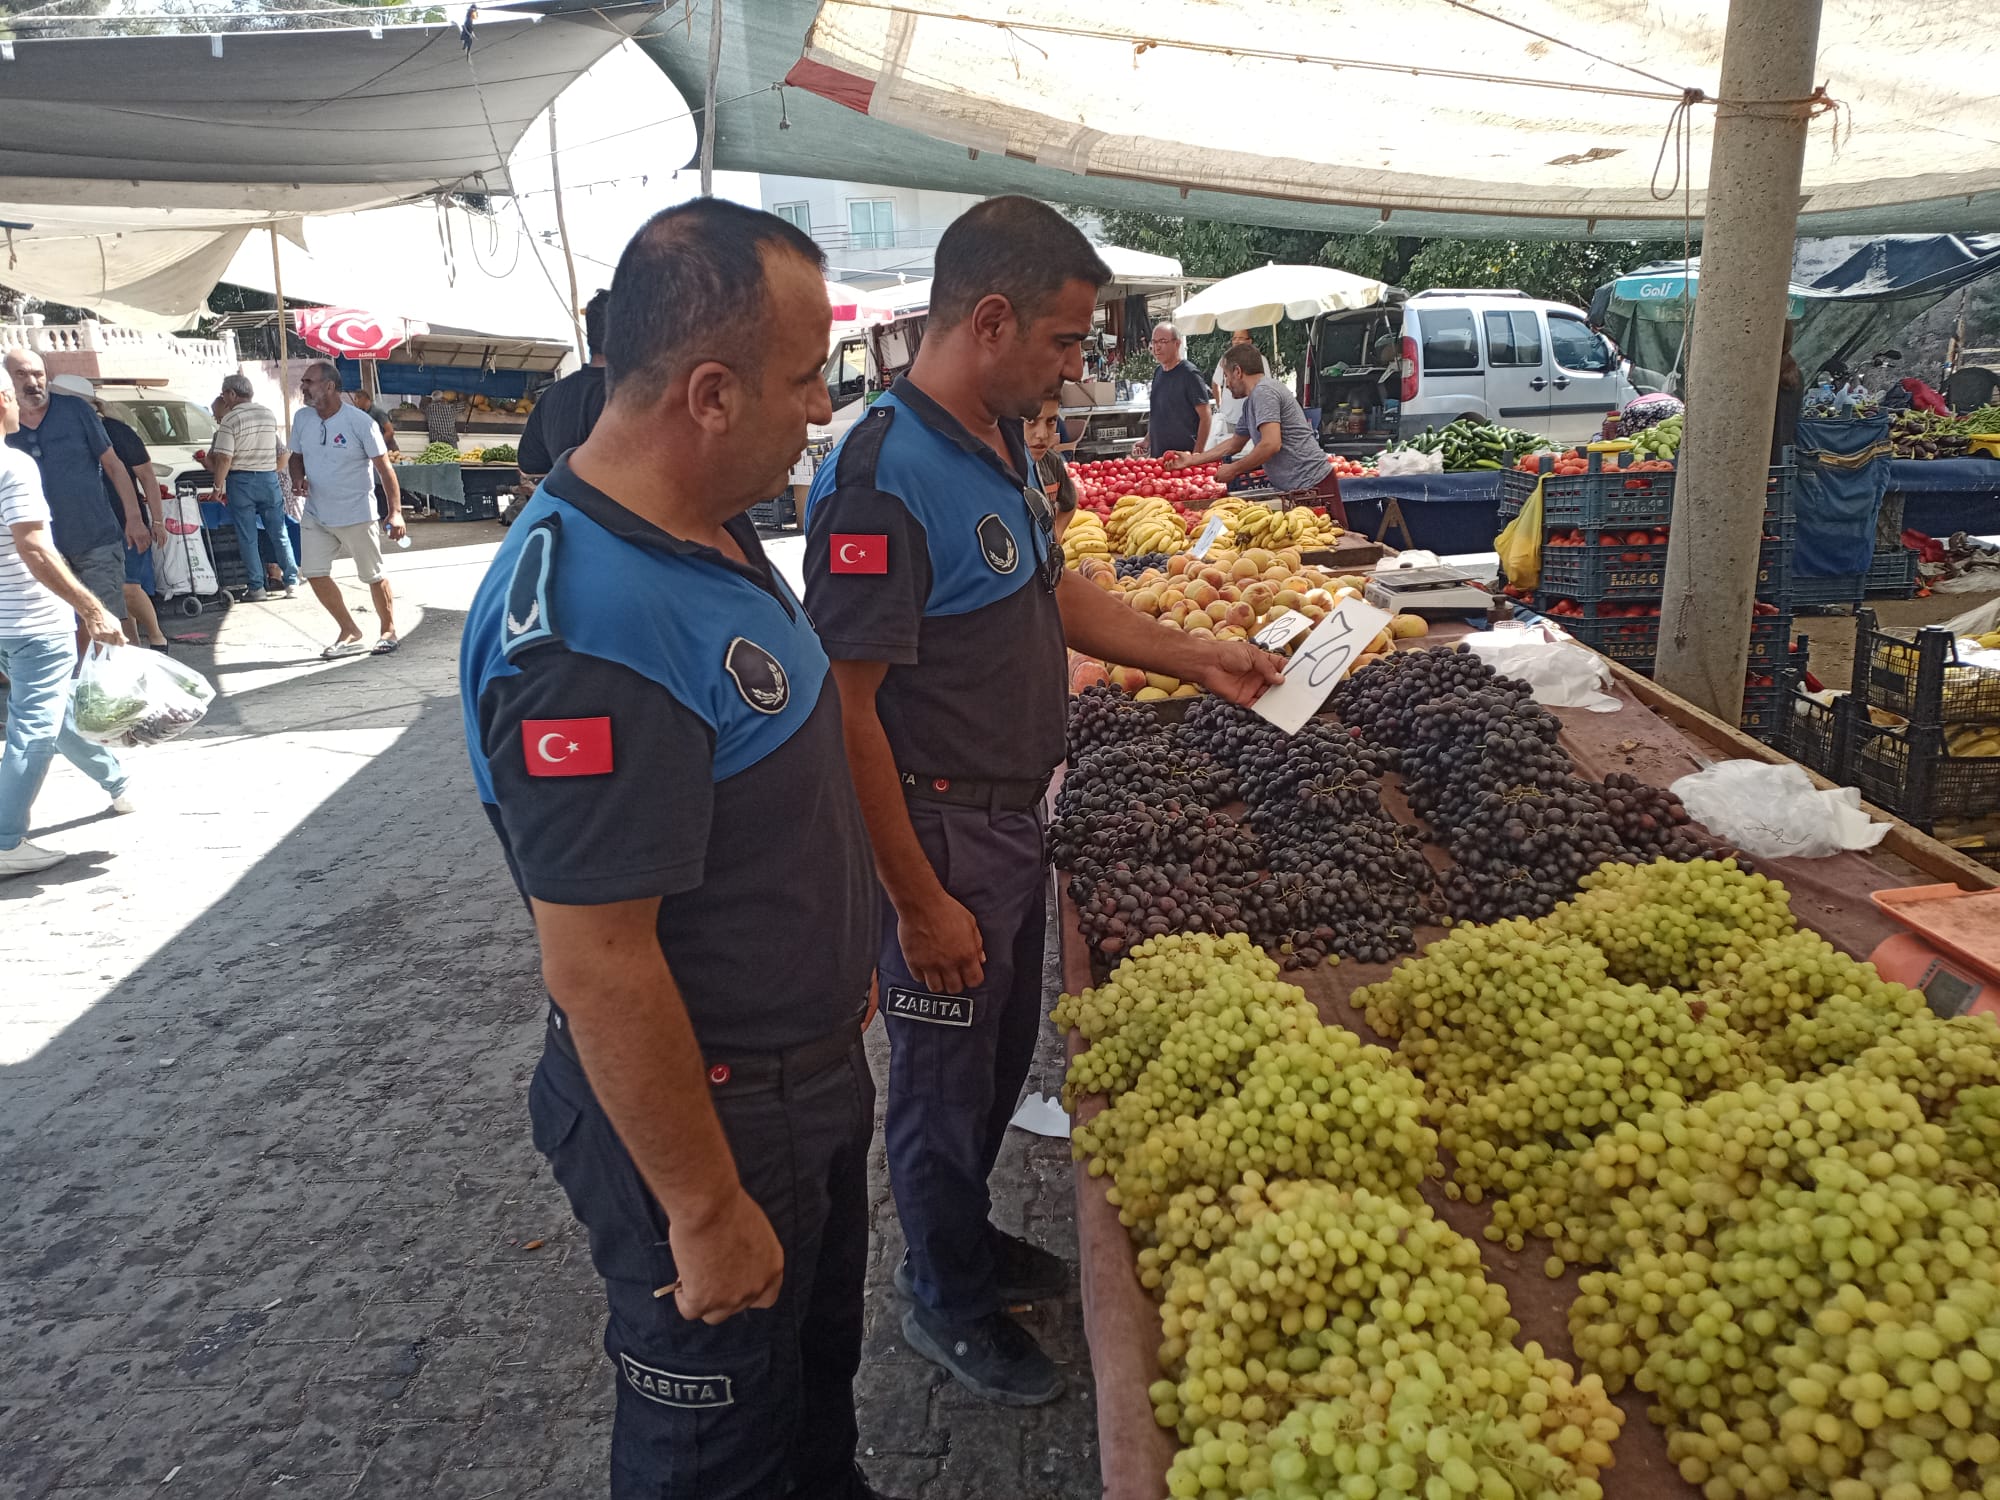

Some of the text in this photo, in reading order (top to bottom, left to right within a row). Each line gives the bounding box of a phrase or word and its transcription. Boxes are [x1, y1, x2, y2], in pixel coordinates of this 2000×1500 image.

[1640, 282, 1673, 297] Golf
[1284, 610, 1353, 688] 70
[895, 993, 962, 1018] ZABITA
[629, 1366, 717, 1401] ZABITA
